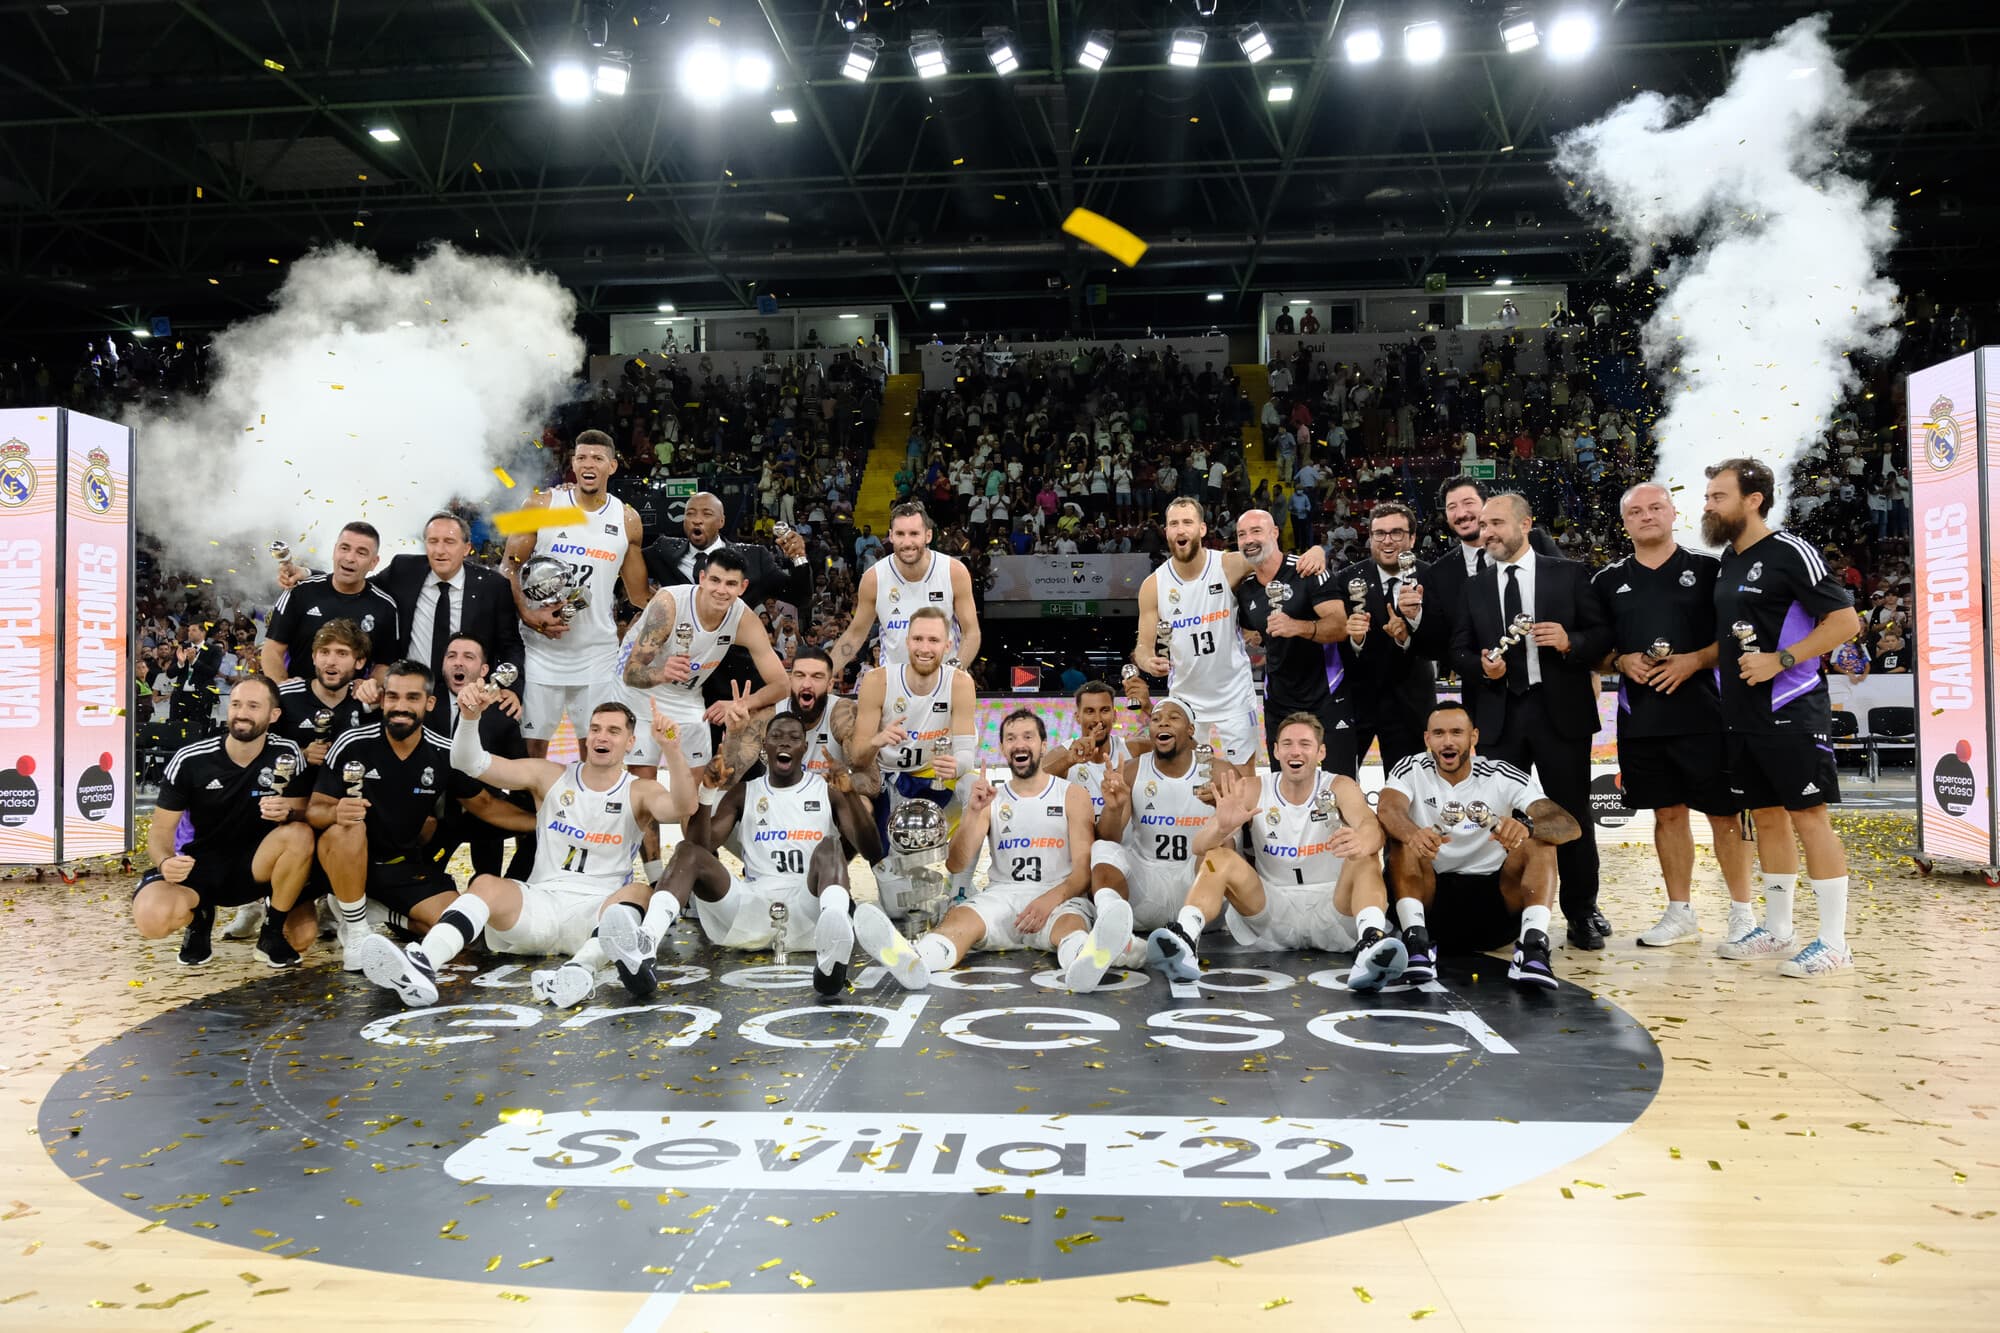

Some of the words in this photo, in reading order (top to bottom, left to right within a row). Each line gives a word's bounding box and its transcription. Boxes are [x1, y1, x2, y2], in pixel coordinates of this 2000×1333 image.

[551, 543, 617, 562] AUTOHERO
[1035, 576, 1066, 584] endesa
[1924, 502, 1973, 710] CAMPEONES
[1172, 608, 1229, 629] AUTOHERO
[0, 539, 42, 728] CAMPEONES
[76, 543, 118, 727] CAMPEONES
[1190, 631, 1215, 657] 13
[897, 747, 922, 768] 31
[79, 783, 112, 794] supercopa
[1936, 775, 1972, 786] supercopa
[1939, 785, 1973, 797] endesa
[82, 792, 112, 803] endesa
[548, 820, 623, 845] AUTOHERO
[754, 830, 823, 842] AUTOHERO
[997, 838, 1065, 850] AUTOHERO
[561, 844, 589, 873] 11
[1155, 834, 1187, 861] 28
[771, 849, 804, 874] 30
[1011, 856, 1041, 882] 23
[1292, 868, 1304, 885] 1
[360, 995, 1520, 1054] endesa
[532, 1128, 1087, 1177] Sevilla
